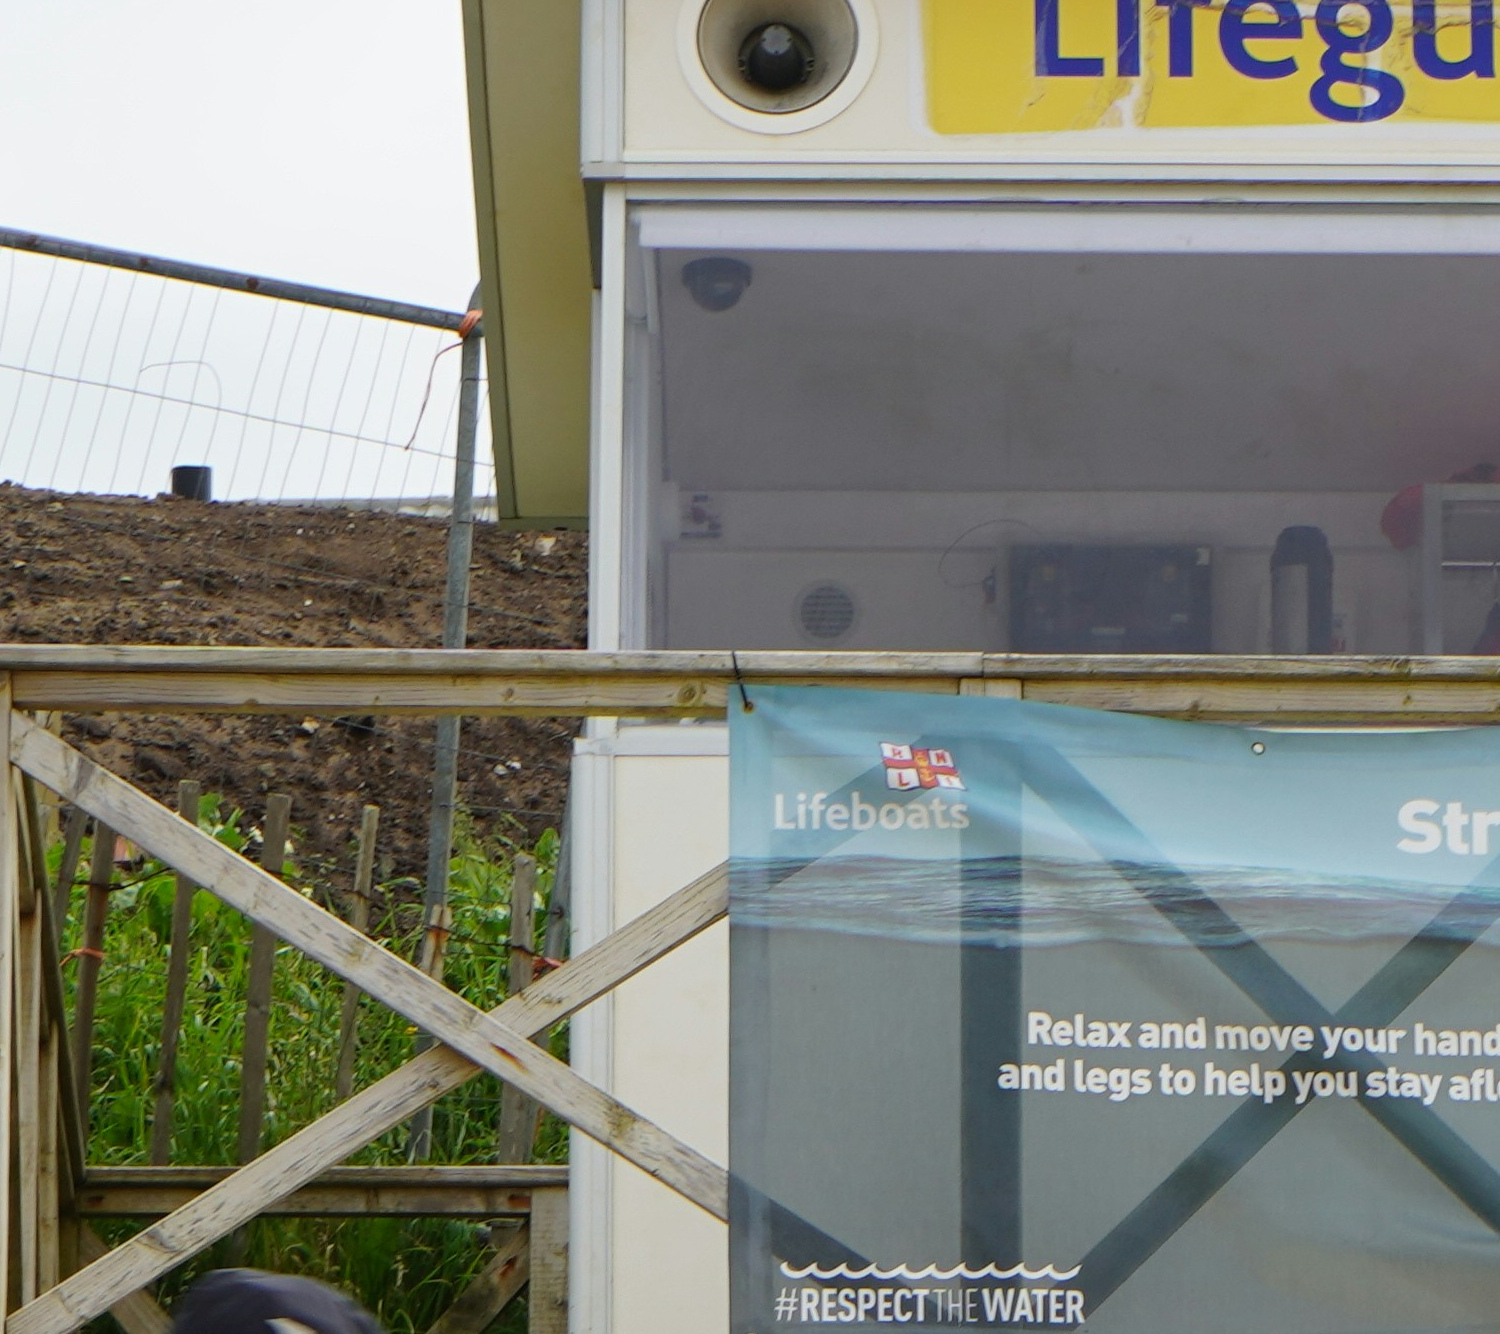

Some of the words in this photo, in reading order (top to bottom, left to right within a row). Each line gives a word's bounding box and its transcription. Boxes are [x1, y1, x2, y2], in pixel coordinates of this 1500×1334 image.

[773, 791, 970, 831] Lifeboats
[1027, 1011, 1131, 1048] Relax
[1138, 1017, 1206, 1050] and
[1214, 1025, 1313, 1052] move
[1320, 1026, 1406, 1059] your
[998, 1058, 1066, 1091] and
[1074, 1060, 1150, 1101] legs
[1159, 1063, 1196, 1095] to
[1204, 1062, 1286, 1103] help
[1292, 1072, 1358, 1104] you
[1366, 1069, 1443, 1105] stay
